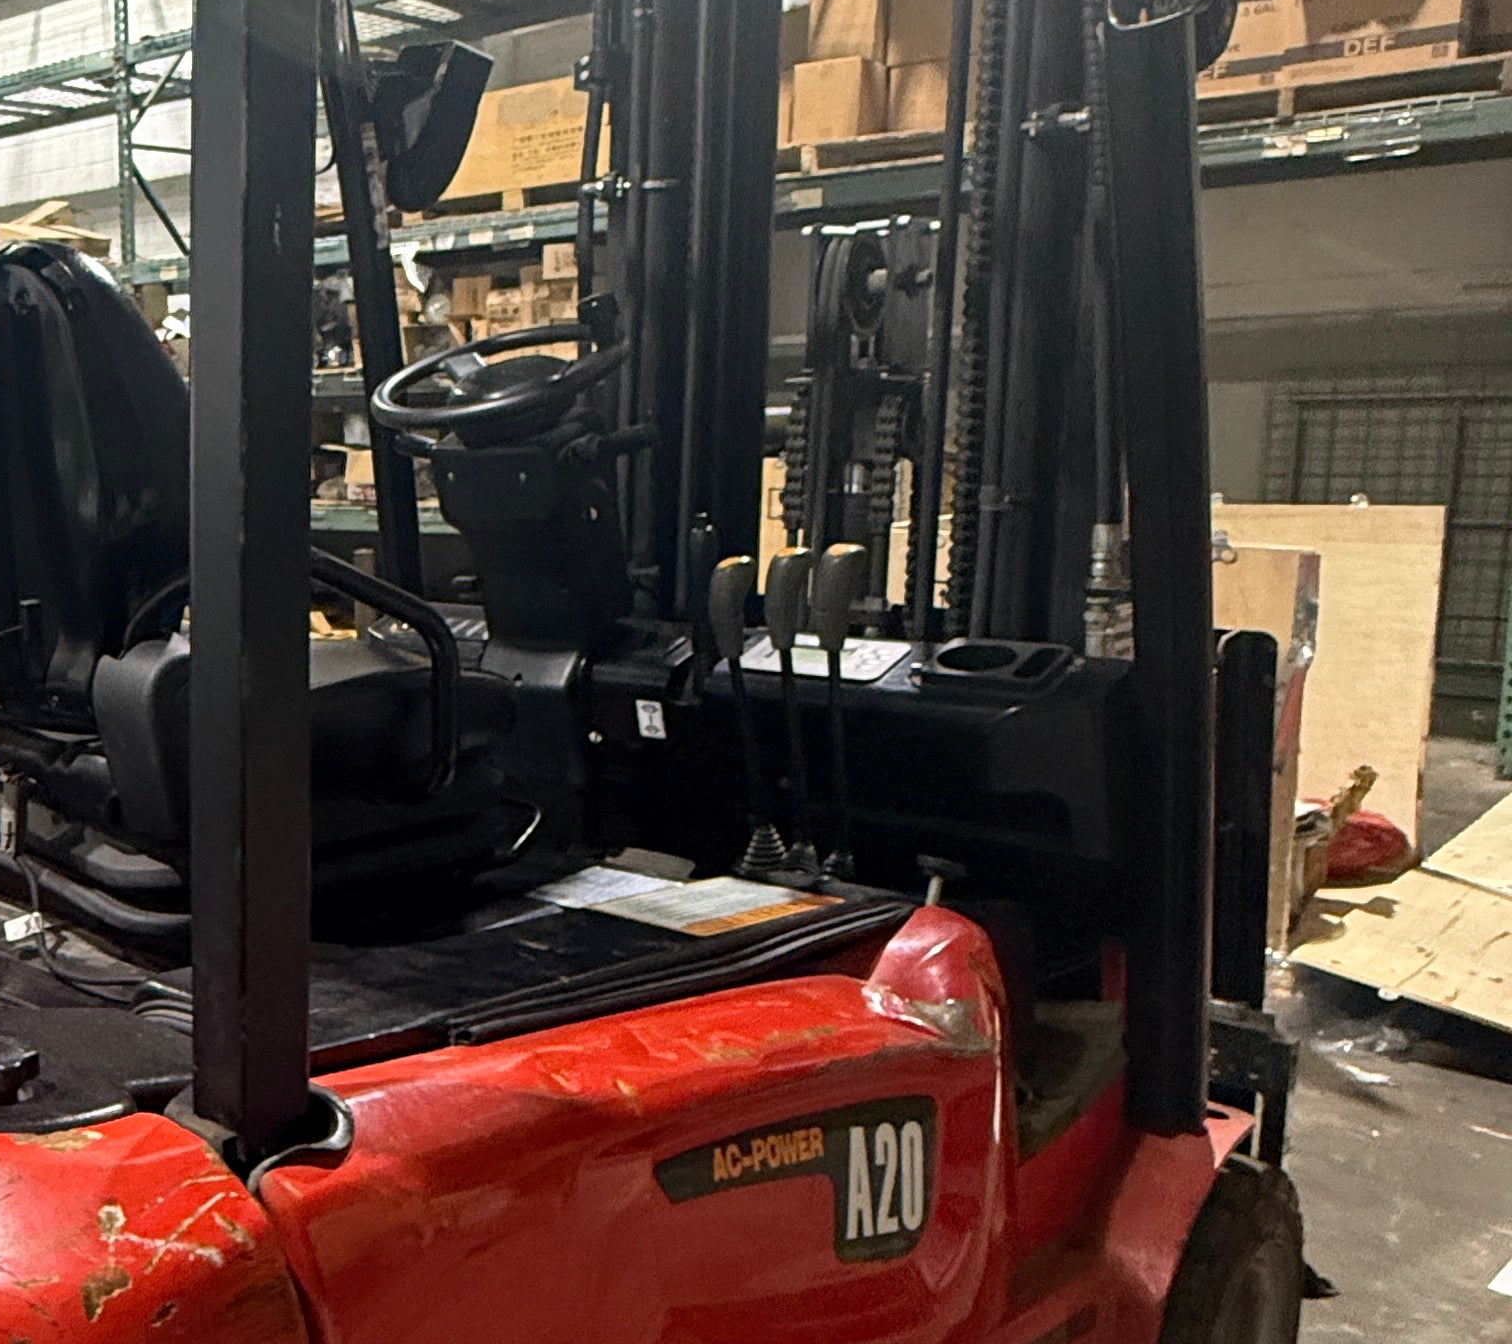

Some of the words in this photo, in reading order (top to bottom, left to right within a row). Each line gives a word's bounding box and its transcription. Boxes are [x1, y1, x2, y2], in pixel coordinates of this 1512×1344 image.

[1343, 35, 1395, 57] DEF
[712, 1127, 825, 1183] AC-POWER
[845, 1120, 925, 1241] A20
